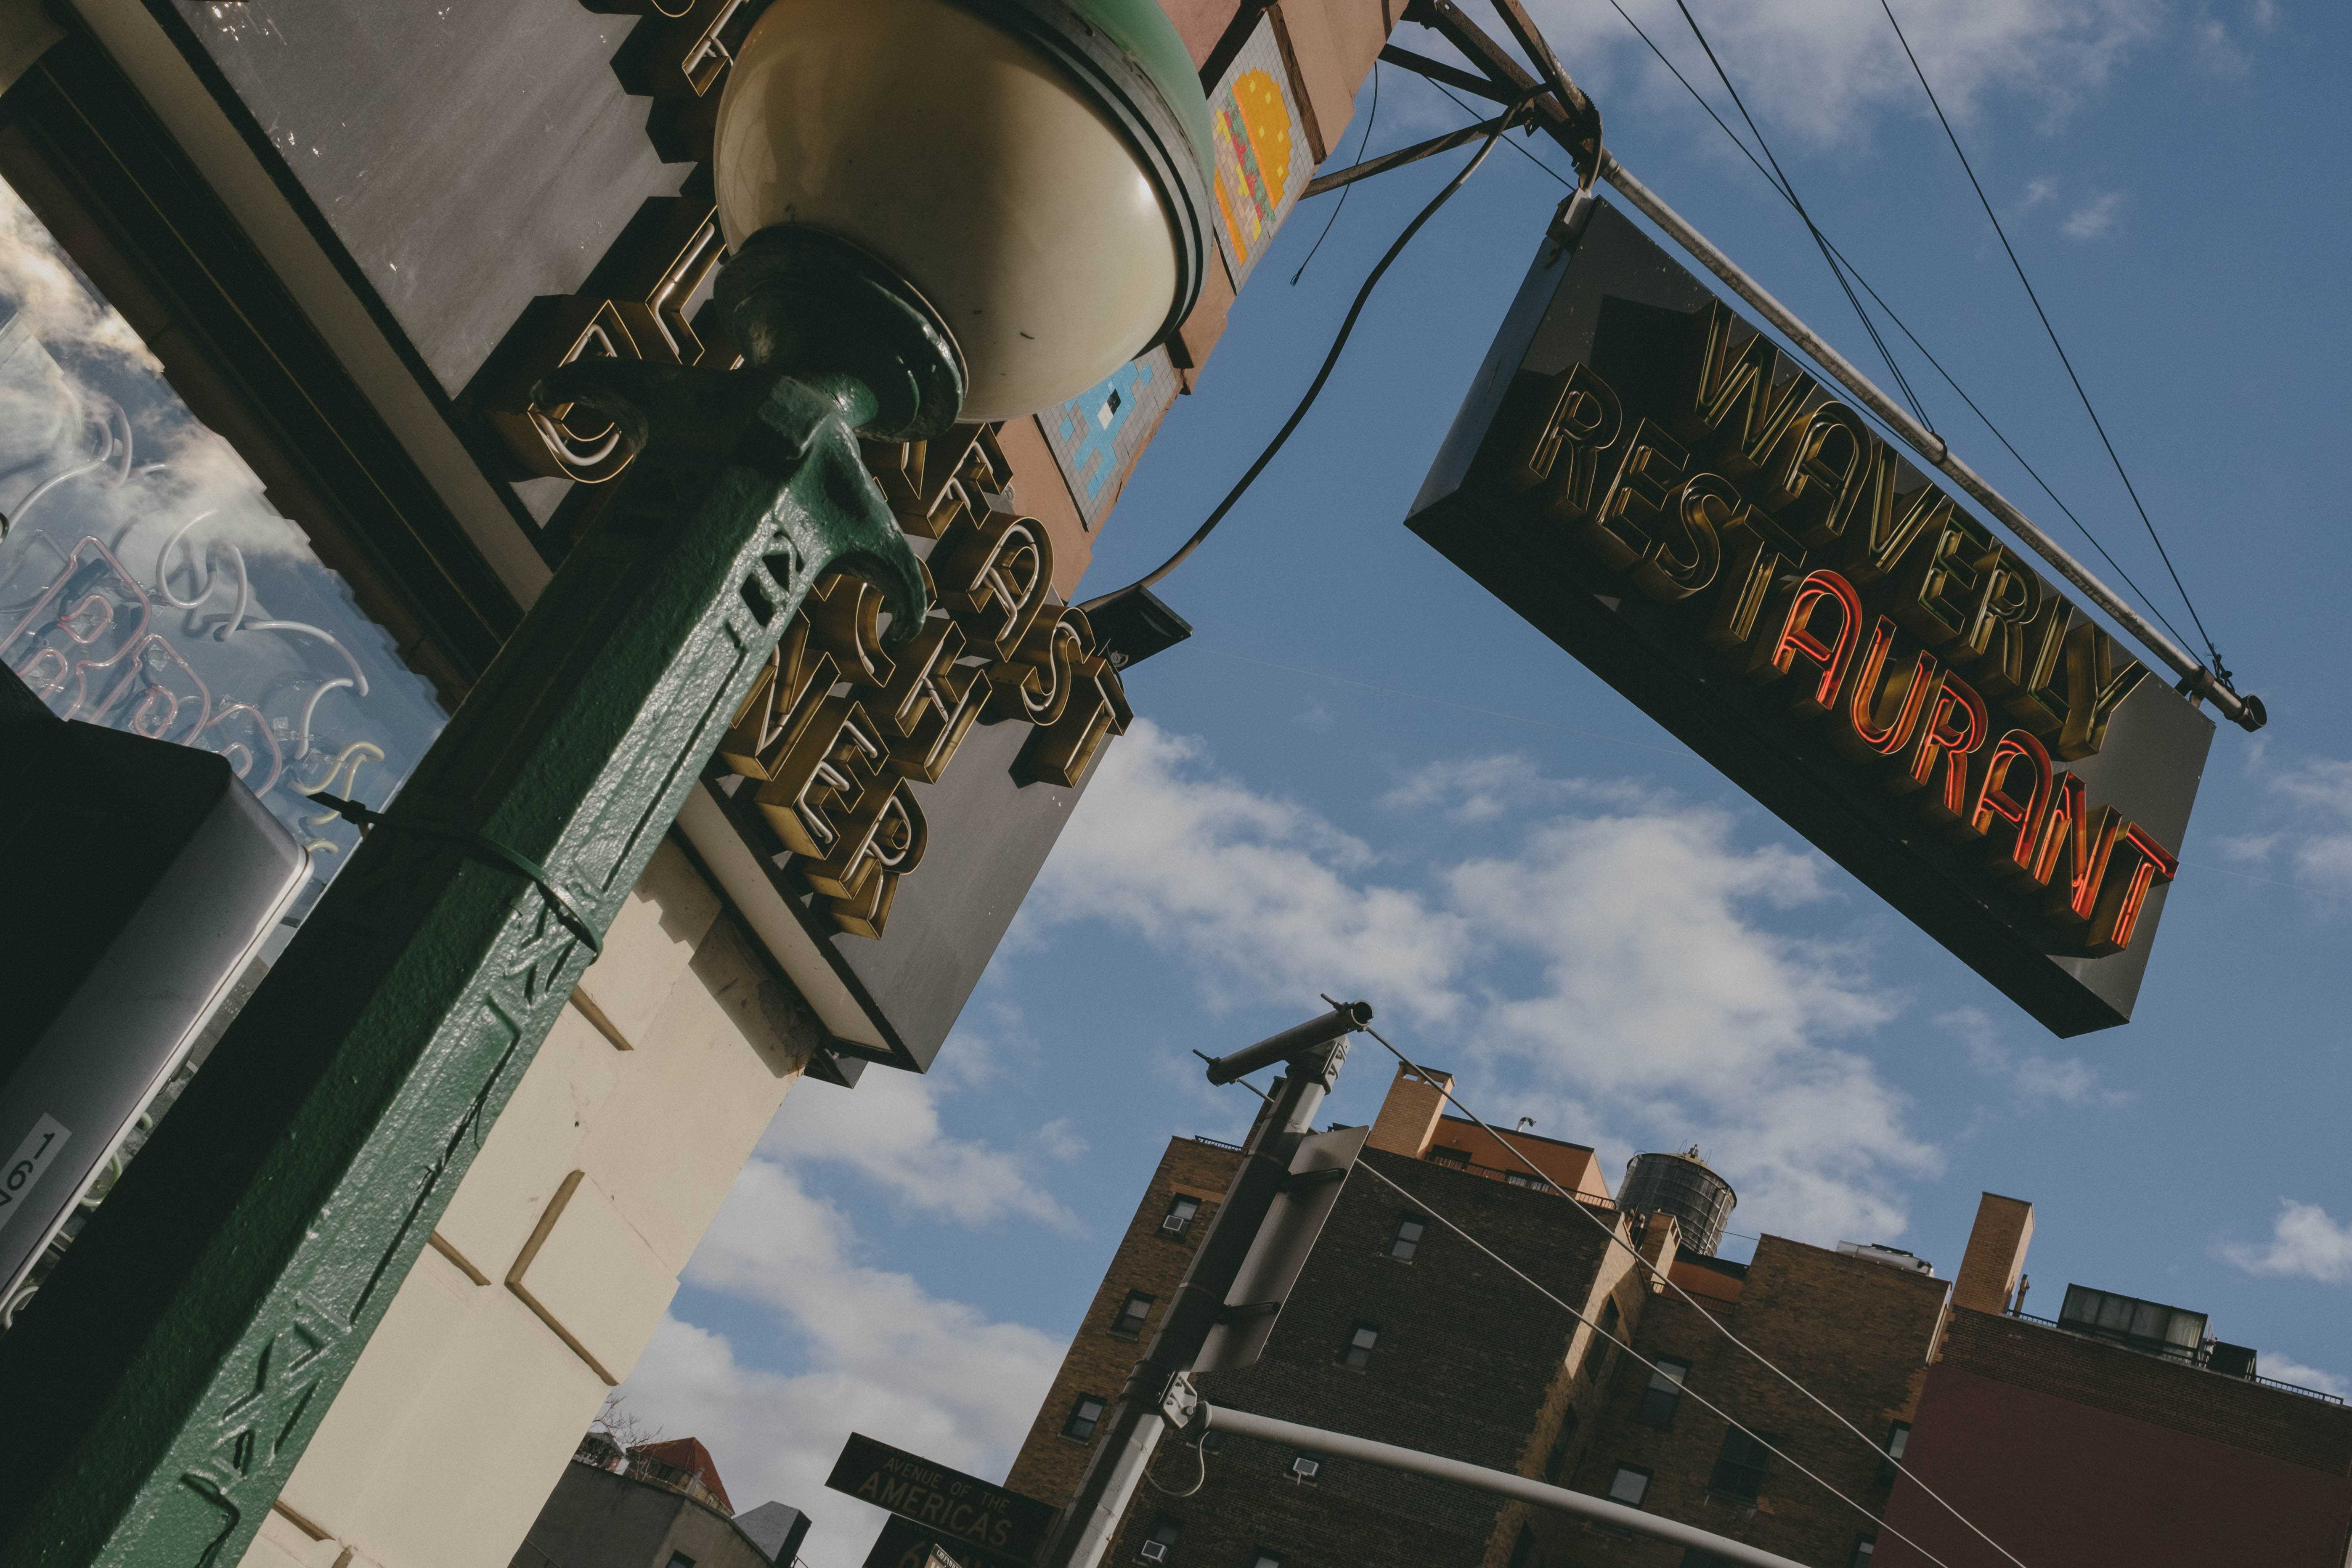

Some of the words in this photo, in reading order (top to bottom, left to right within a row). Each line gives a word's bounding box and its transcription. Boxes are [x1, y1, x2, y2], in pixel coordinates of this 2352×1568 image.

[527, 300, 928, 940] DNER
[1528, 361, 2180, 950] RESTAURANT
[1695, 299, 2150, 757] WAVERLY
[857, 1471, 1012, 1547] AMERICAS
[883, 1457, 943, 1488] AVENUE
[949, 1480, 972, 1498] OF
[981, 1491, 1010, 1513] THE
